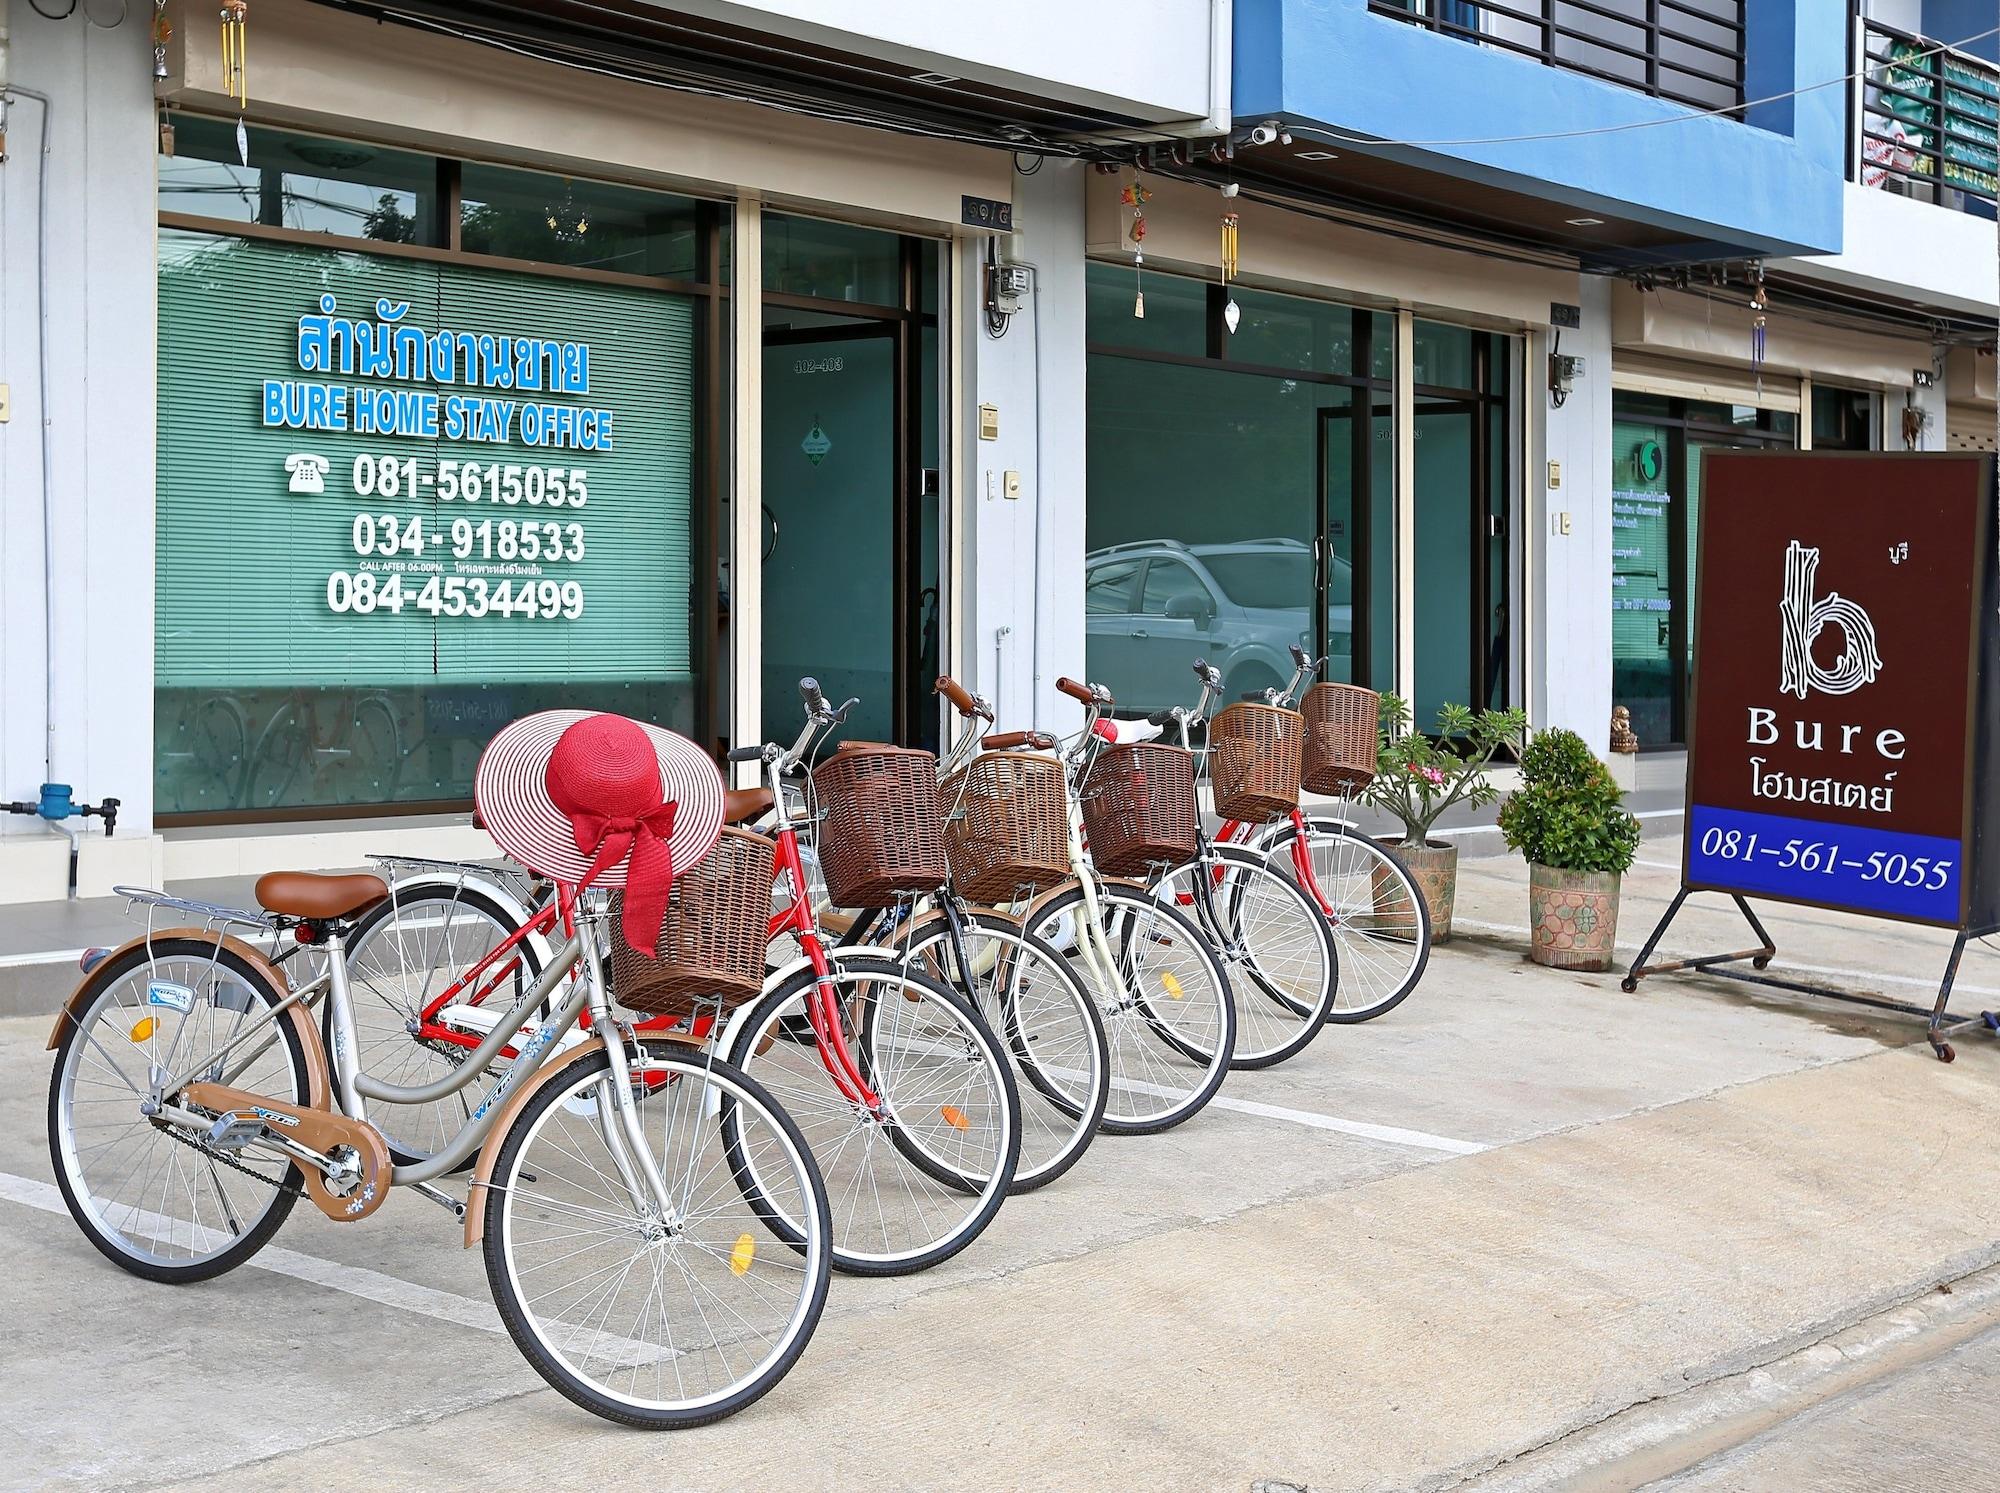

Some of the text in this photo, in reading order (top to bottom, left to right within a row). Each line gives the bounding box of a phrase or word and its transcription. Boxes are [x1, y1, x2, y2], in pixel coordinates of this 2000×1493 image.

[298, 293, 590, 395] สำนักงานขาย
[794, 357, 843, 373] 402-403
[263, 379, 613, 452] BURE HOME STAY OFFICE
[352, 453, 588, 508] 081-5615055
[359, 562, 382, 572] CALL
[382, 562, 405, 573] AFTER
[1888, 541, 1909, 565] บูรี
[327, 571, 584, 620] 084-4534499
[1747, 707, 1906, 759] Bure
[1750, 757, 1897, 812] โฮมสเตย์
[1701, 828, 1952, 891] 081-561-5055
